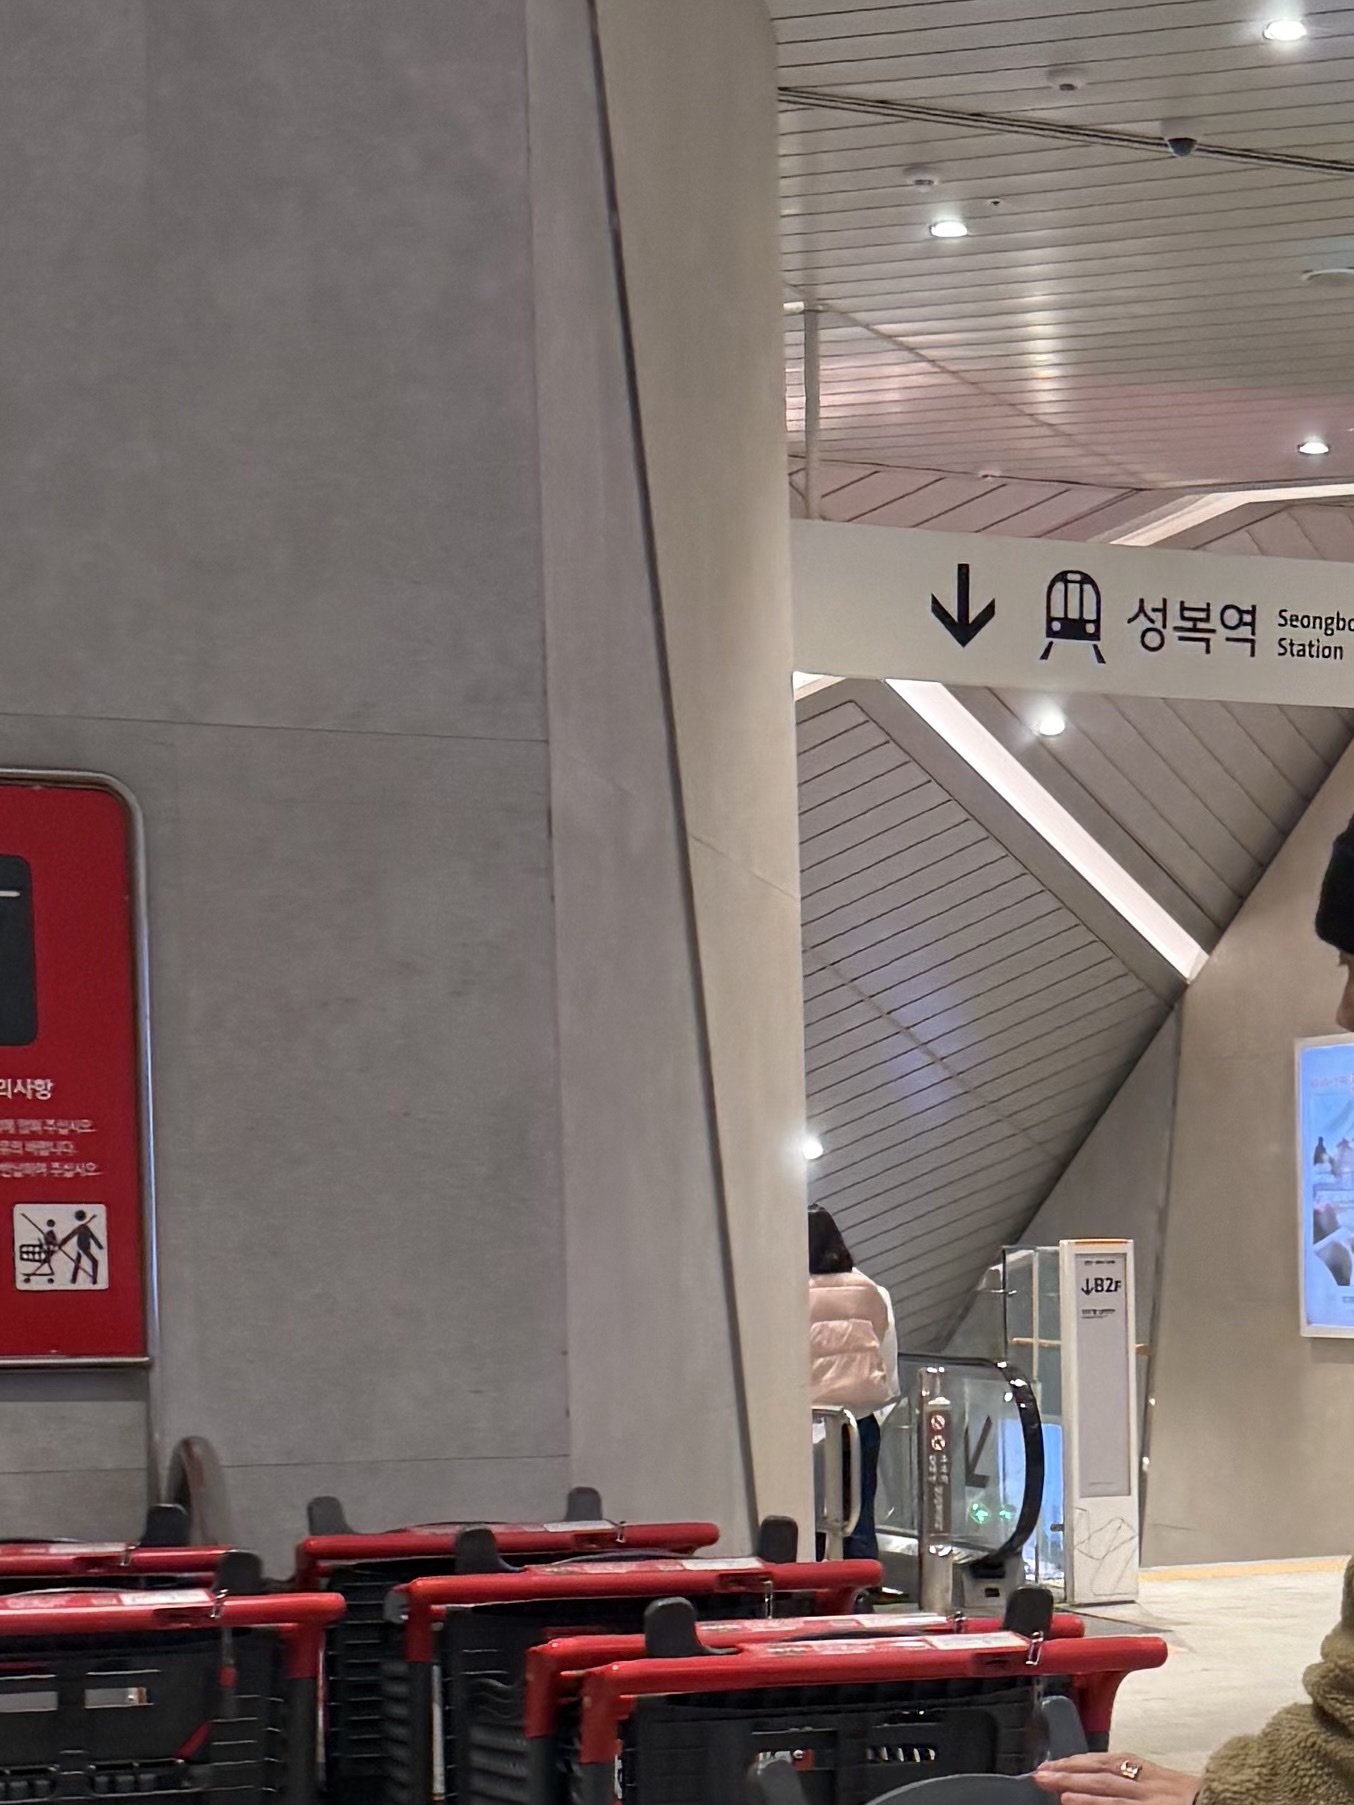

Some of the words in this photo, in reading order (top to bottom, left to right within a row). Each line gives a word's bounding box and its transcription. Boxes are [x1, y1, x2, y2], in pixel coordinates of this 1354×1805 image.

[1127, 597, 1257, 658] 성복역
[1277, 636, 1345, 660] Station
[1093, 1277, 1122, 1293] B2F
